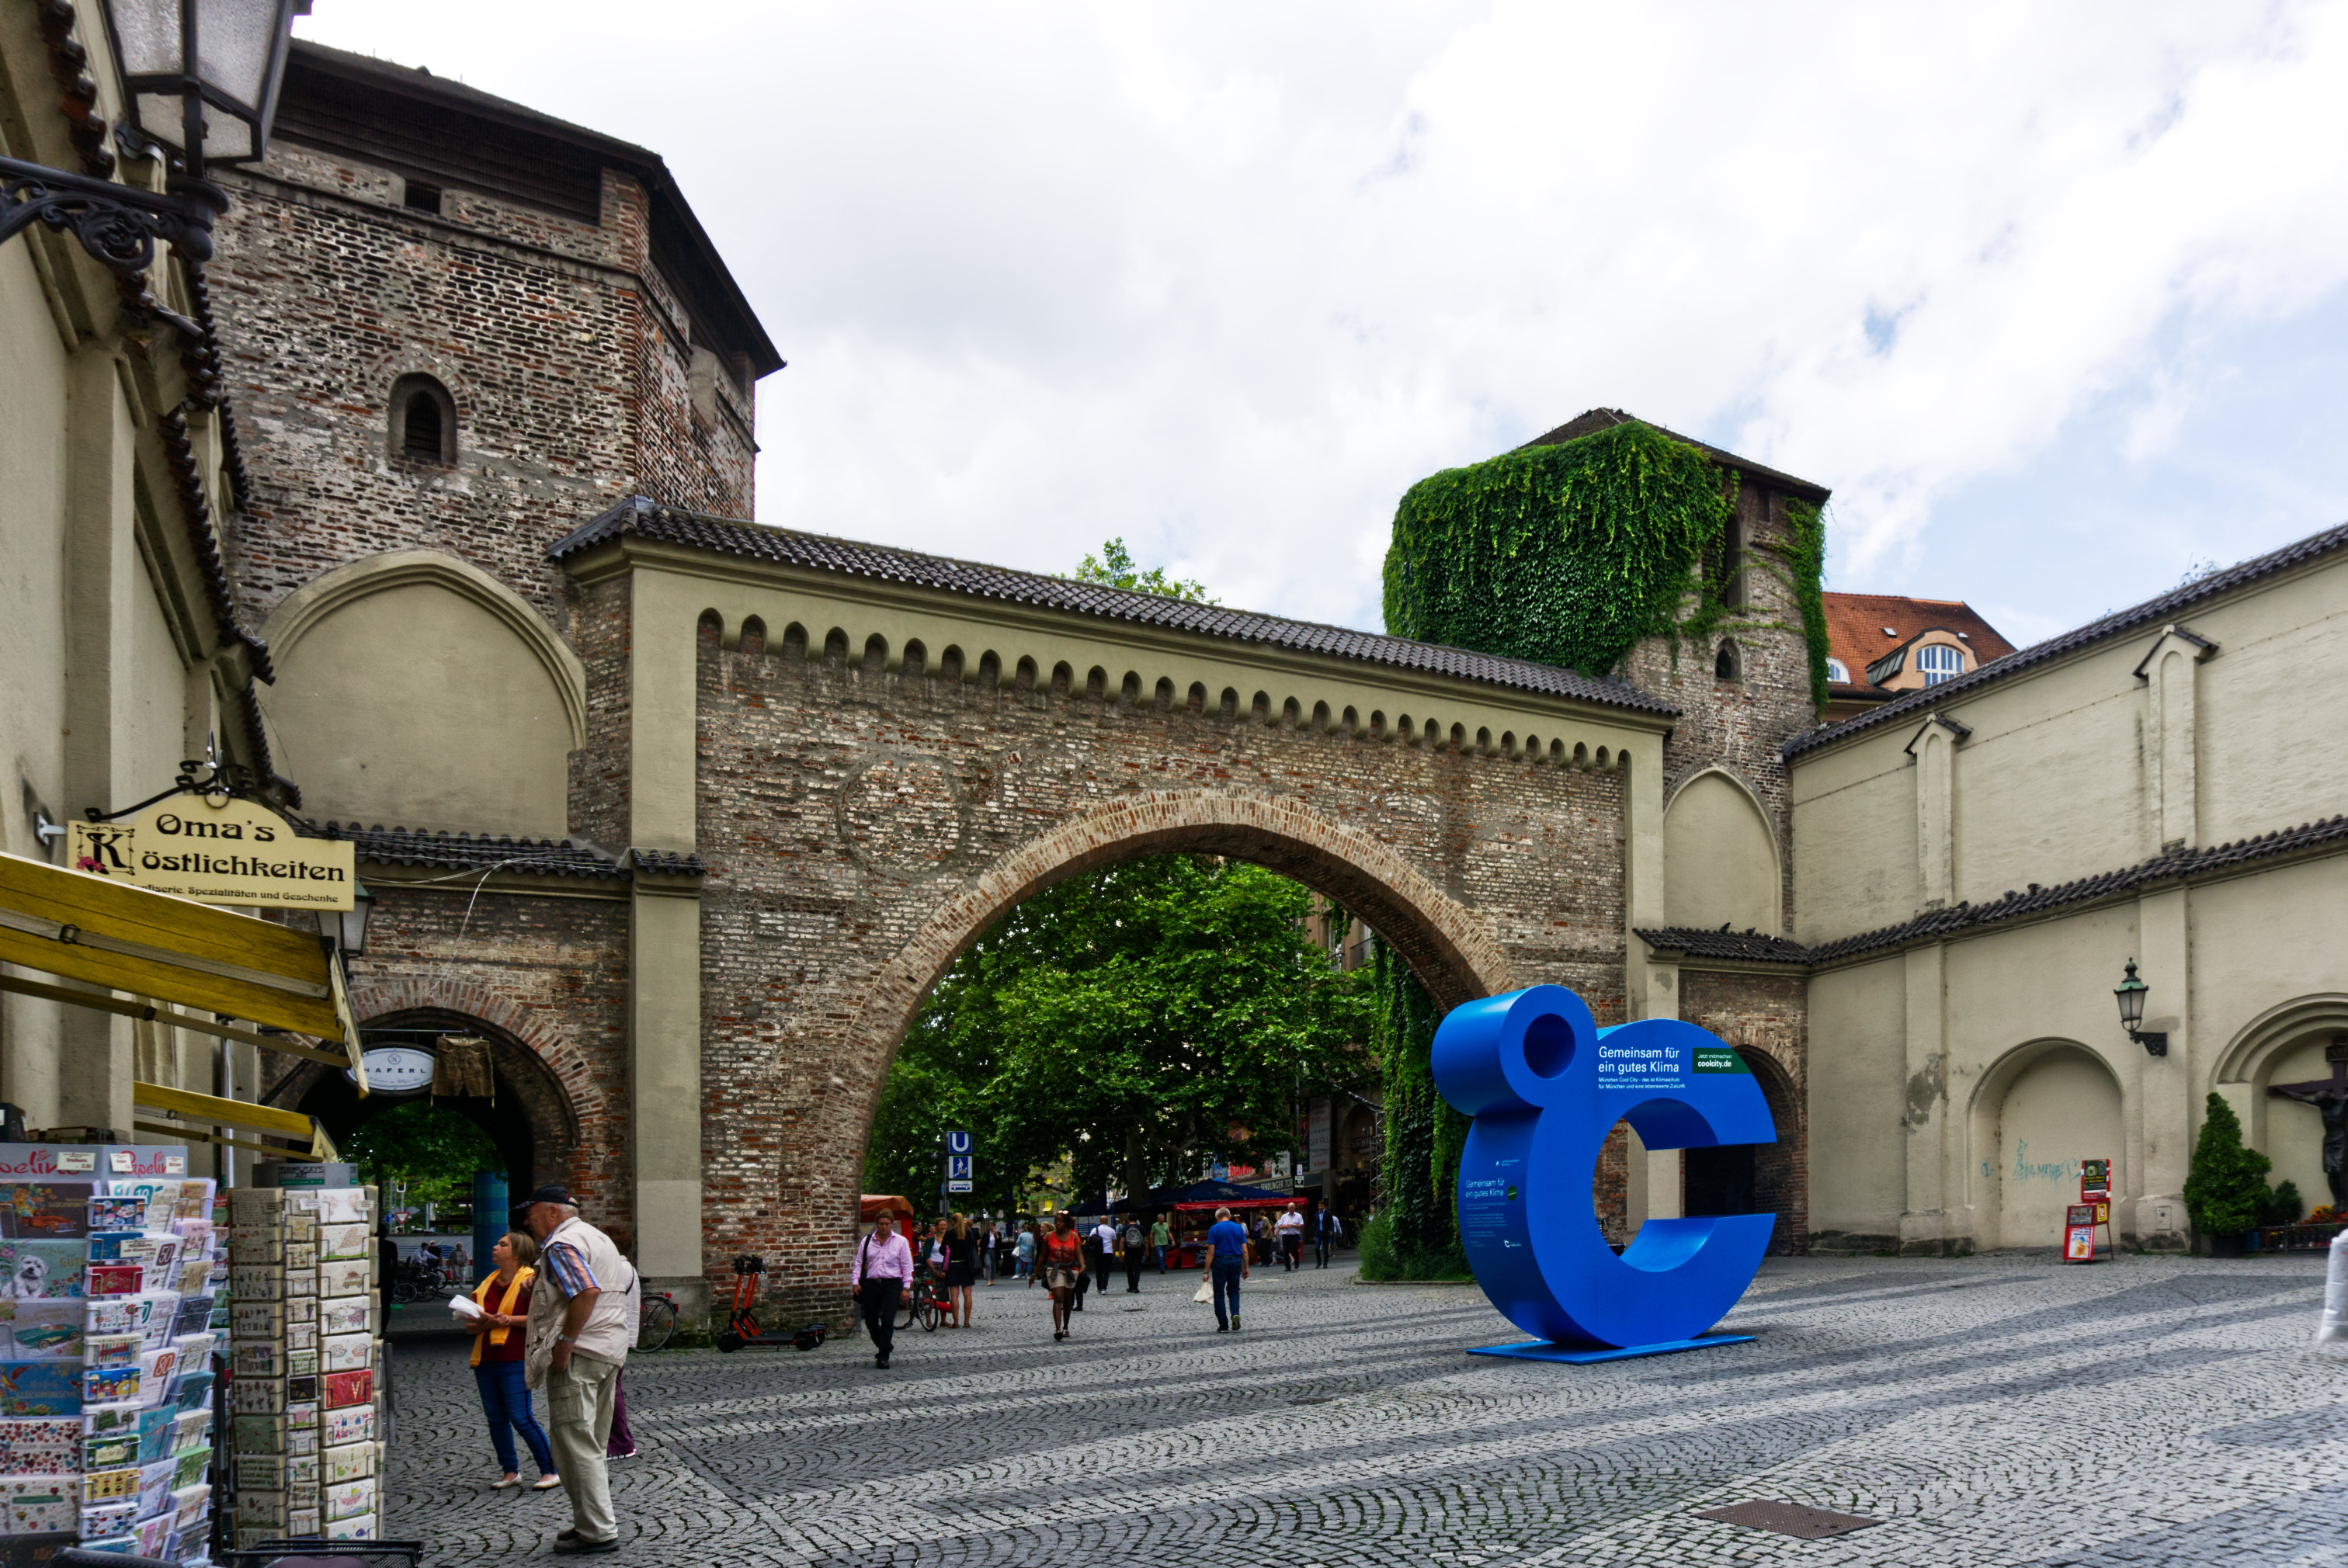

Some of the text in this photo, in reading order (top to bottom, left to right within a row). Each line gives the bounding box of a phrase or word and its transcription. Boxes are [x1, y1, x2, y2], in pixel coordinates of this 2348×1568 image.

[156, 813, 276, 842] Oma's
[188, 886, 257, 898] Spezialitäten
[260, 890, 280, 900] und
[282, 892, 339, 903] Geschenke
[1599, 1046, 1679, 1059] Gemeinsam für
[1598, 1060, 1679, 1075] ein gutes Klima
[1697, 1060, 1732, 1069] coolcity.de
[952, 1133, 969, 1152] U
[1465, 1178, 1506, 1188] Gemeinsam für
[1474, 1190, 1488, 1199] gutes
[1489, 1188, 1504, 1197] Klima
[159, 1245, 174, 1263] 50
[156, 1355, 173, 1375] 80
